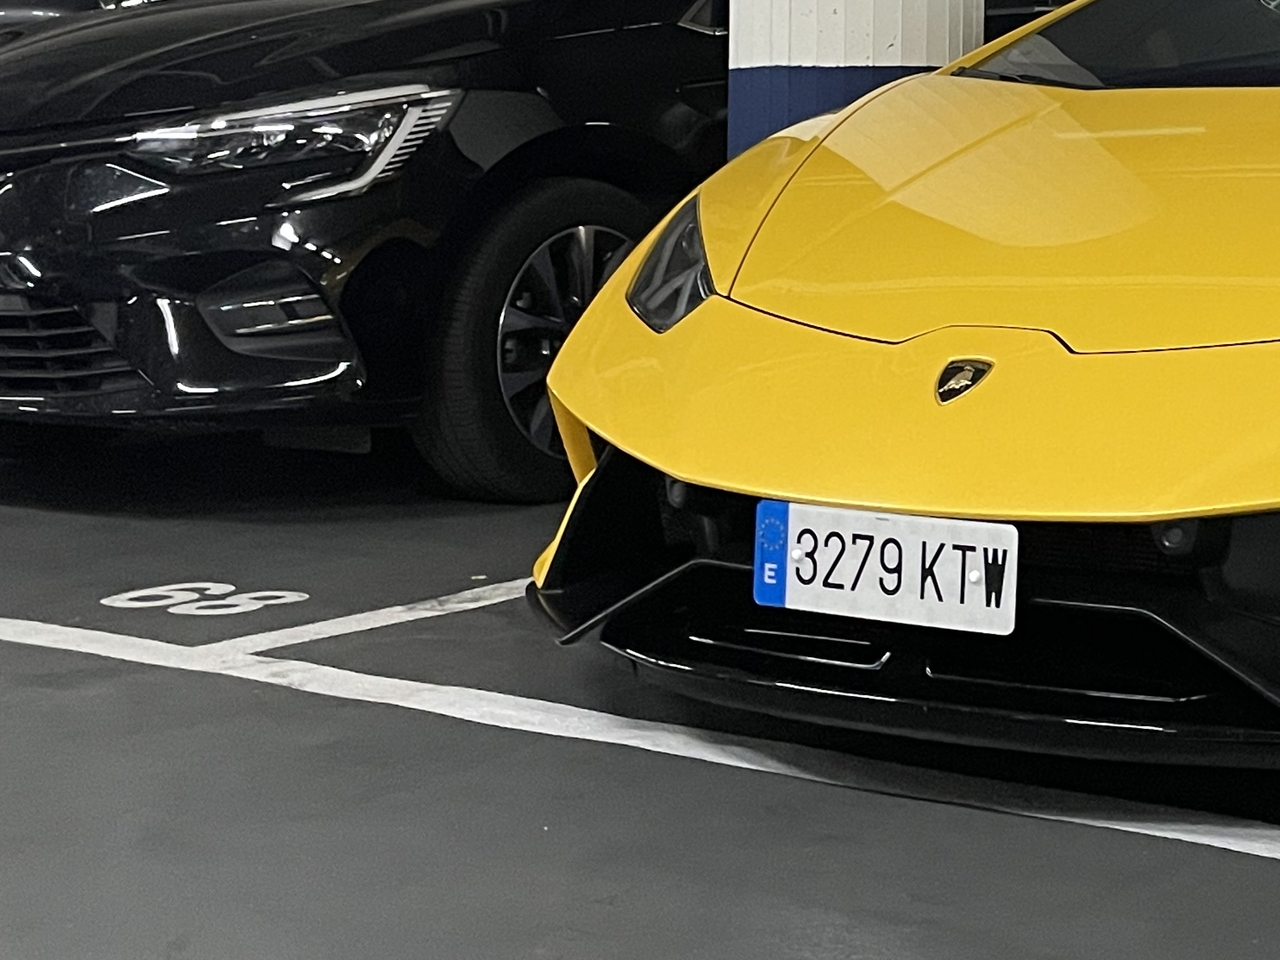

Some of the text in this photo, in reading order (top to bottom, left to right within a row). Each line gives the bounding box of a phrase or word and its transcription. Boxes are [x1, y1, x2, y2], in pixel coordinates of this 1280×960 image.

[763, 563, 778, 584] E
[795, 527, 1008, 608] 3279 KTW
[100, 582, 310, 615] 68
